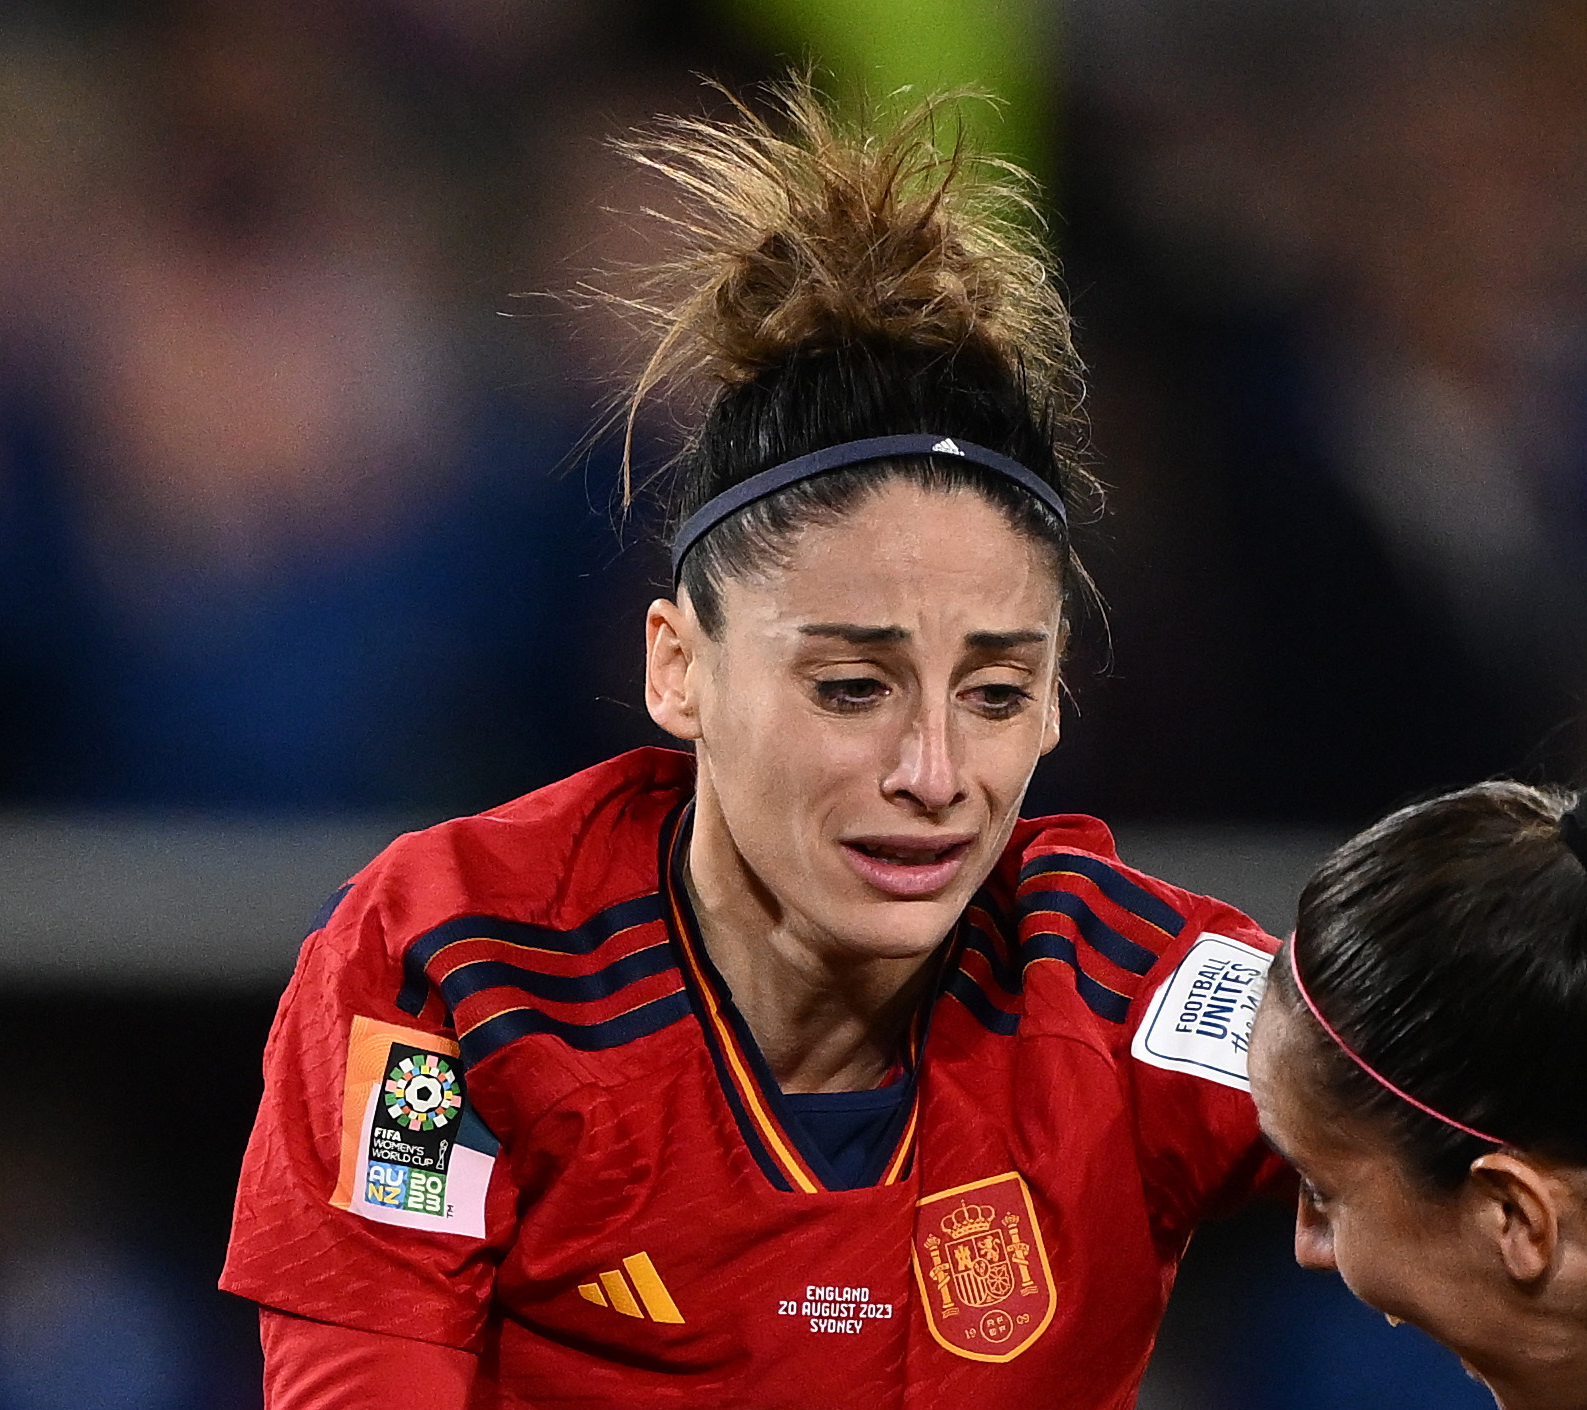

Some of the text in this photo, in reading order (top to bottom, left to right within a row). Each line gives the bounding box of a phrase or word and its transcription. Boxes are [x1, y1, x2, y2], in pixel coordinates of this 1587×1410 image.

[1175, 958, 1231, 1033] FOOTBALL
[1195, 963, 1262, 1040] UNITES
[374, 1127, 402, 1142] FIFA
[372, 1138, 425, 1156] WOMEN'S
[371, 1148, 434, 1167] WORLD CUP
[368, 1165, 404, 1187] AU
[410, 1172, 443, 1195] 20
[367, 1182, 401, 1205] NZ
[407, 1190, 442, 1212] 23
[806, 1285, 869, 1302] ENGLAND
[777, 1300, 893, 1319] 20 AUGUST 2023
[809, 1318, 863, 1334] SYDNEY
